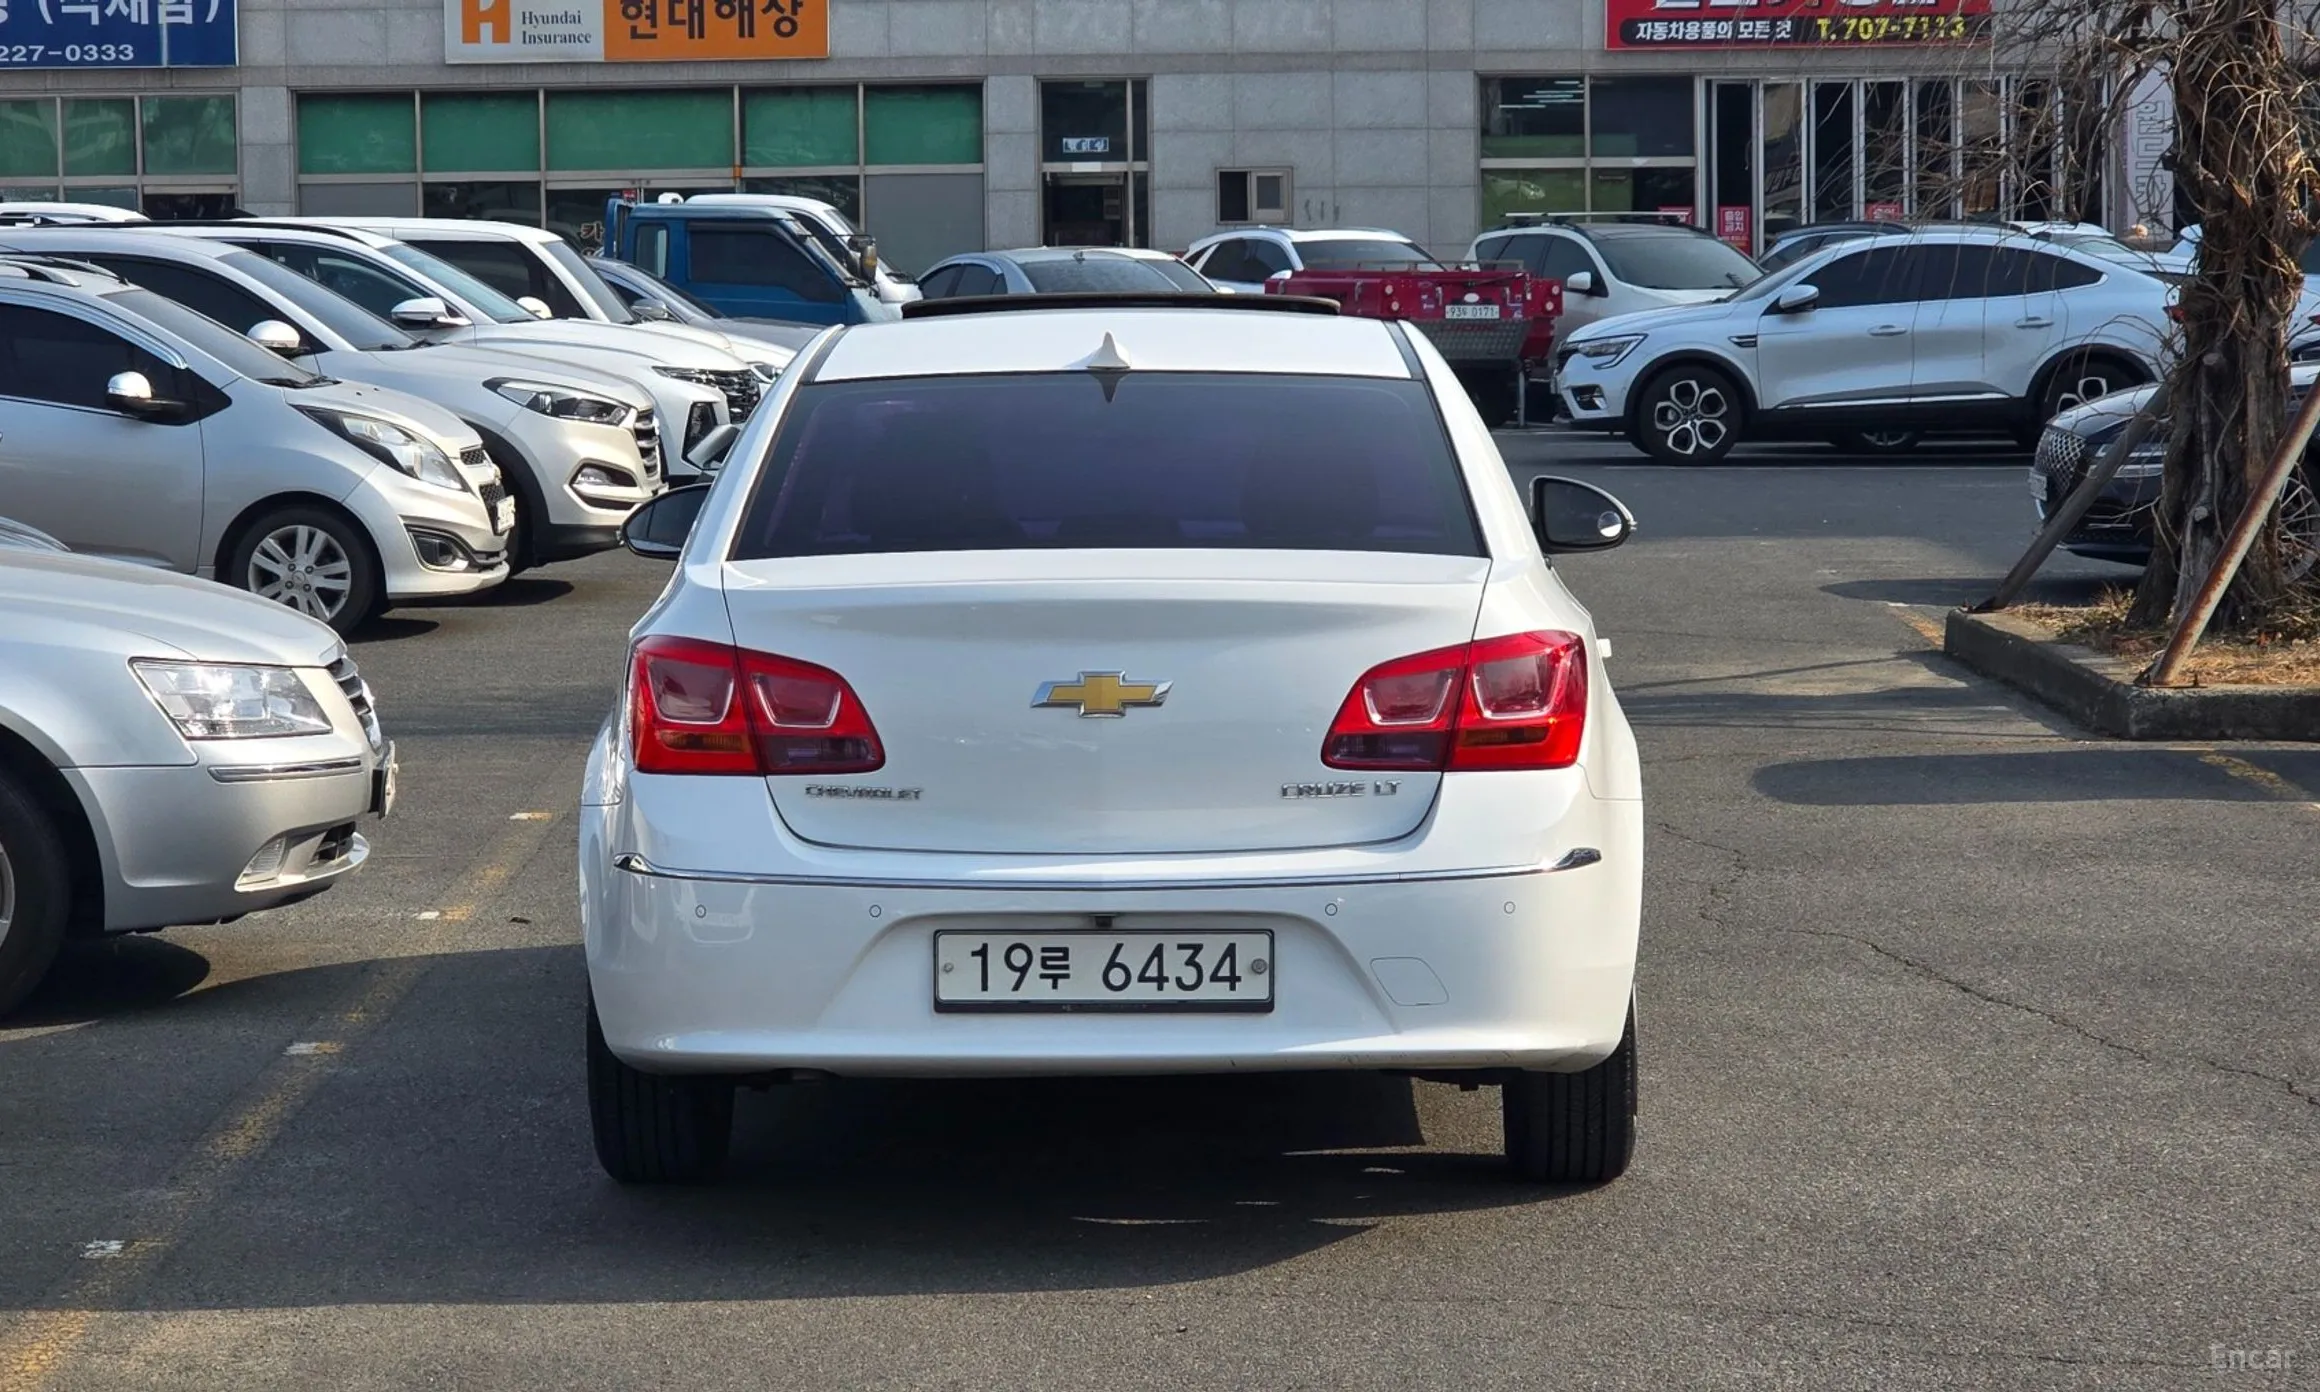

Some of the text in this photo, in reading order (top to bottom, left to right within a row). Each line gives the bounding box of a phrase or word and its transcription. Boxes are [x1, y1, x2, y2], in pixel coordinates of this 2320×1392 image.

[521, 10, 582, 28] Hyundai
[621, 0, 804, 40] 현대해상
[521, 31, 592, 45] Insurance
[1636, 21, 1733, 40] 자동차용품의
[1738, 20, 1770, 39] 모든
[1776, 21, 1792, 39] 것
[805, 784, 922, 800] CHEVROLET
[1282, 780, 1400, 799] CRUZE LT
[971, 942, 1242, 992] 19루 6434
